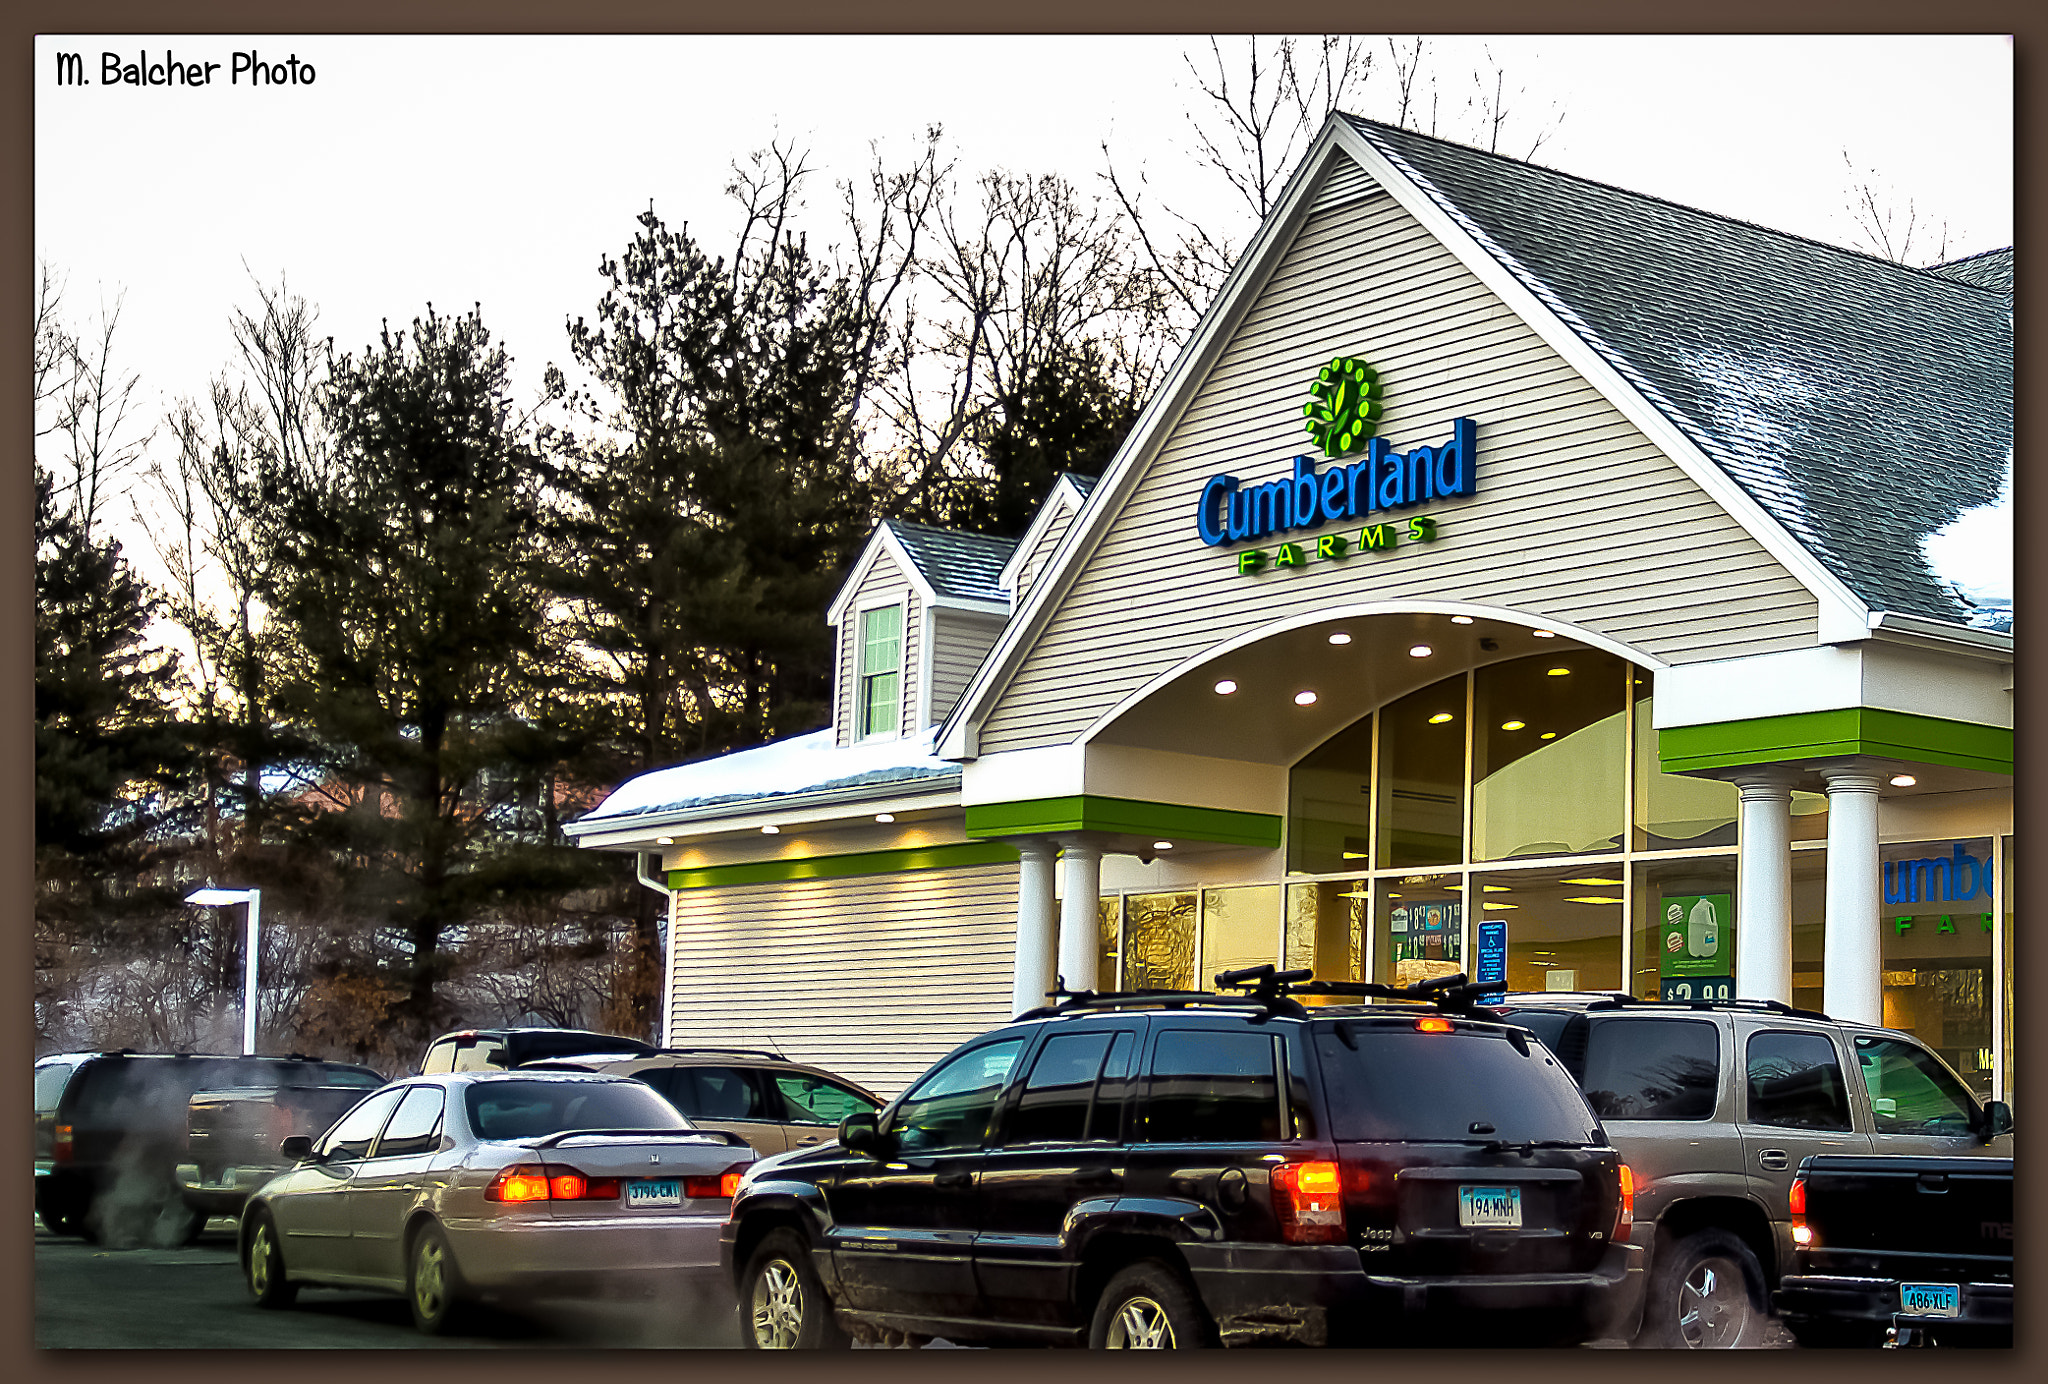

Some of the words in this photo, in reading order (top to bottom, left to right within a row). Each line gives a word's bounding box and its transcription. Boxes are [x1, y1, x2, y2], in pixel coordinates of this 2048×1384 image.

[1197, 417, 1477, 547] Cumberland
[1238, 517, 1437, 575] FARMS
[1360, 1226, 1393, 1241] Jeep
